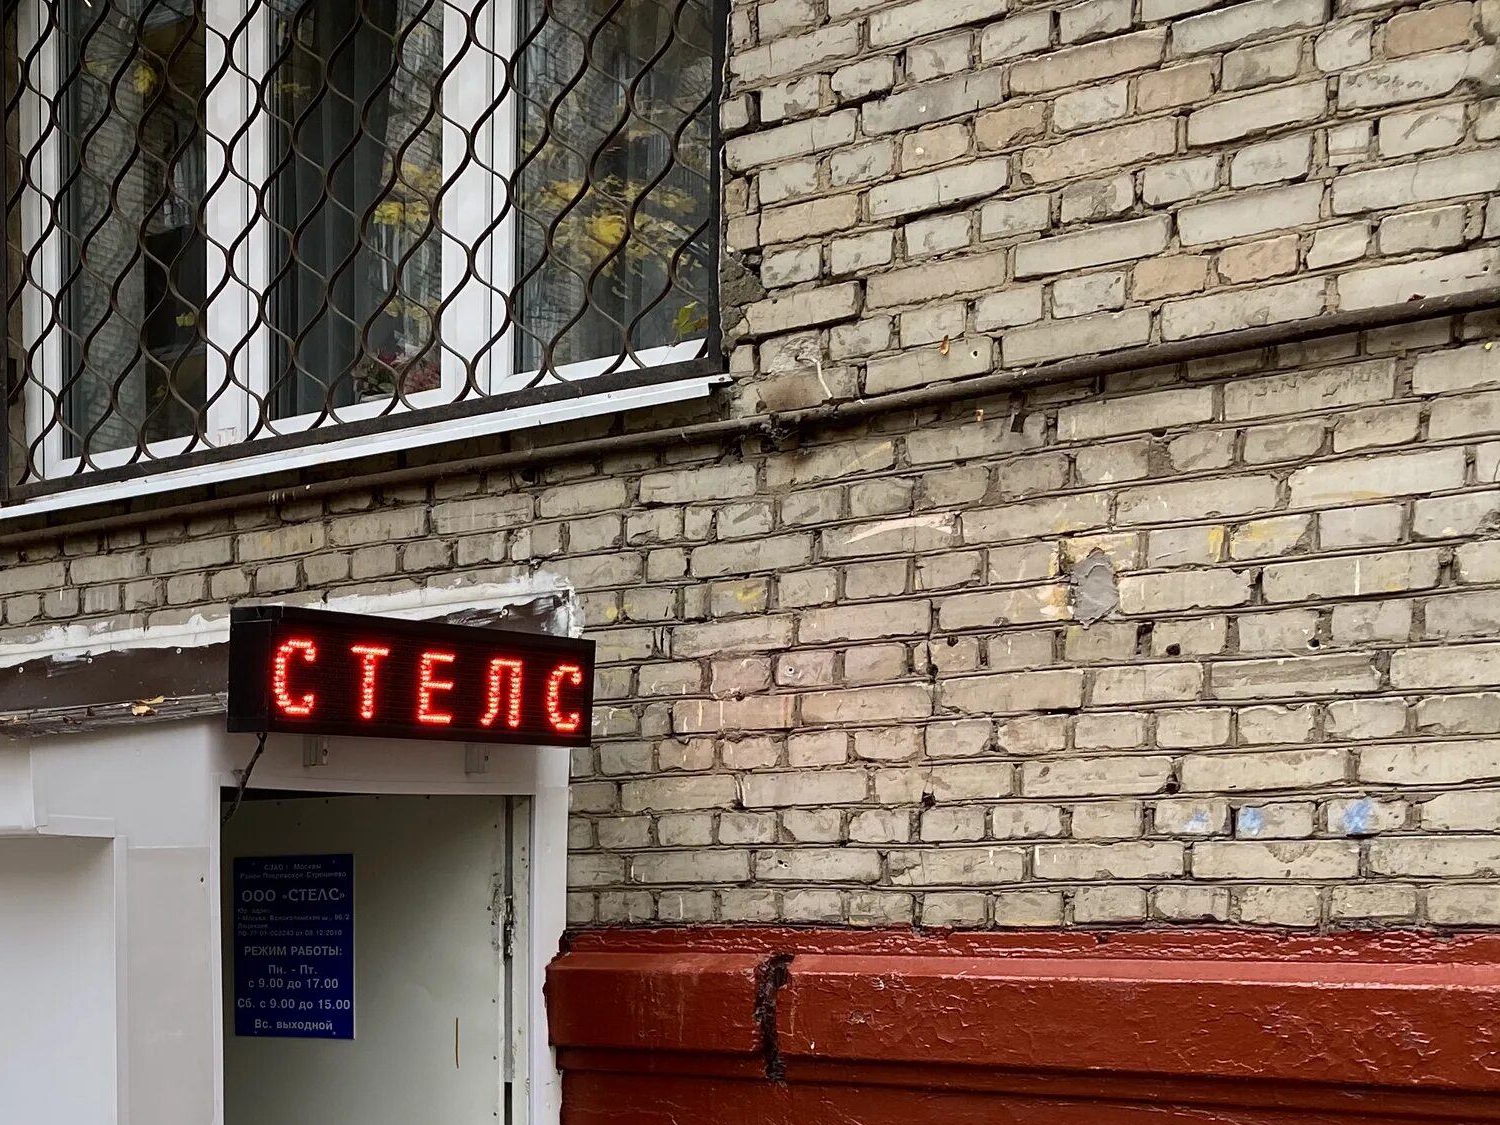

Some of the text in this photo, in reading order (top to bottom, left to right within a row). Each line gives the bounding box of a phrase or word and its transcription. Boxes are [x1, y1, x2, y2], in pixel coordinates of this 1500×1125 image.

[274, 638, 584, 732] СТЕЛС
[242, 888, 345, 902] ООО «СТЕЛС»
[244, 946, 342, 956] РЕЖИМ РАБОТЫ:
[268, 965, 287, 975] Пн.
[300, 965, 318, 975] Пт.
[248, 978, 339, 990] с 9.00 до 17.00
[237, 998, 351, 1011] Сб. с 9.00 до 15.00
[254, 1018, 333, 1031] Вс. выходной
